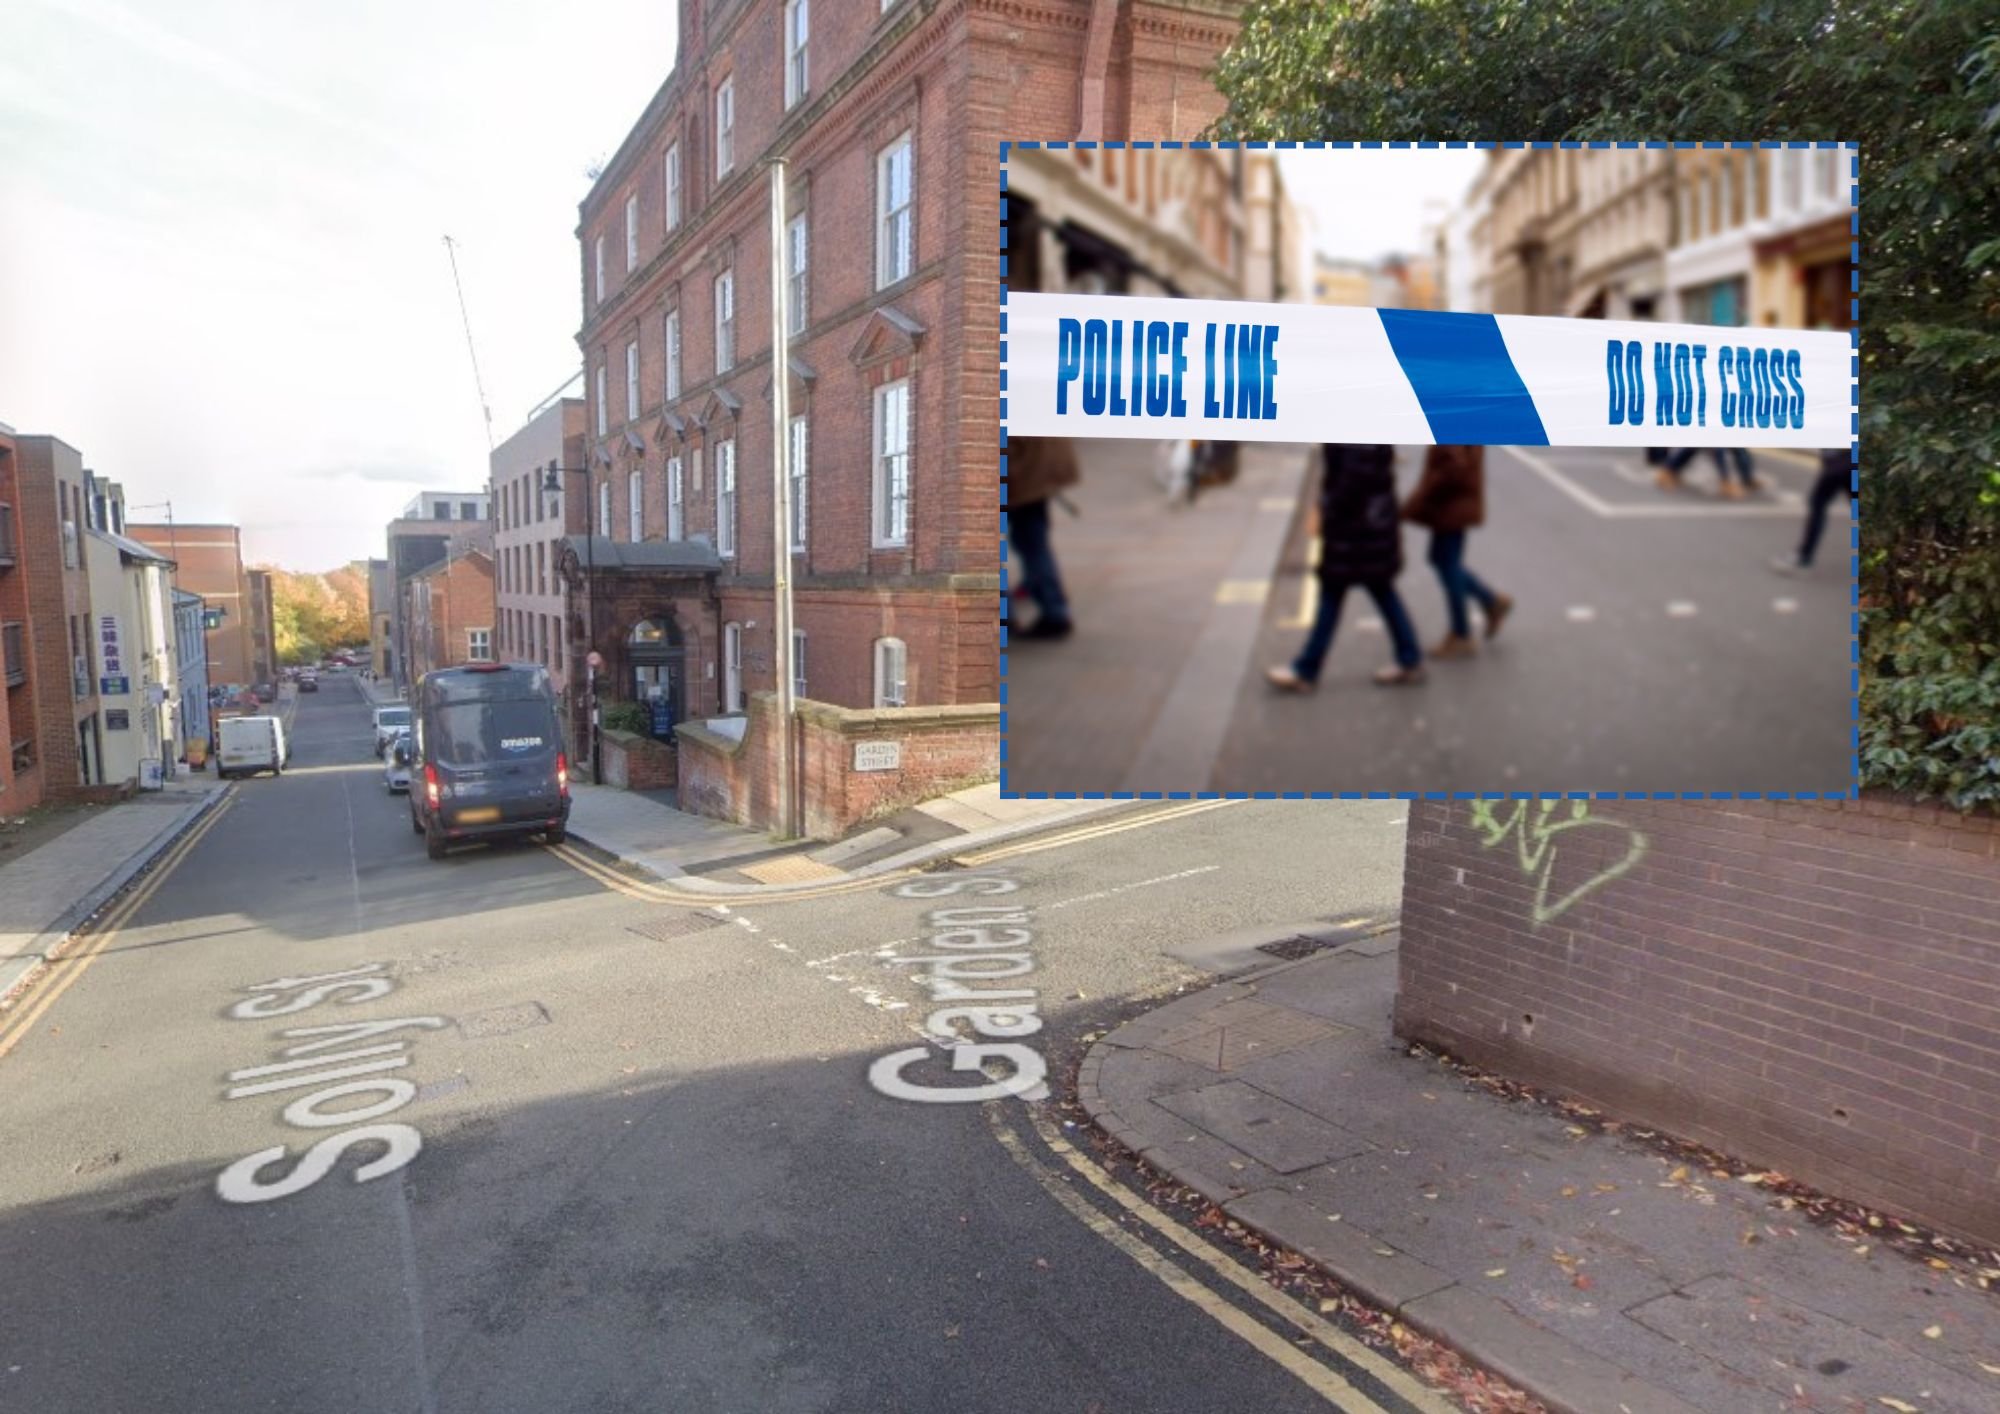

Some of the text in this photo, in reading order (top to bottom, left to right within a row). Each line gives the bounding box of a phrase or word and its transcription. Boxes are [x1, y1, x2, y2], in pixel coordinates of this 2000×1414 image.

[1057, 318, 1279, 420] POLICE LINE
[1607, 340, 1805, 429] DO NOT CROSS
